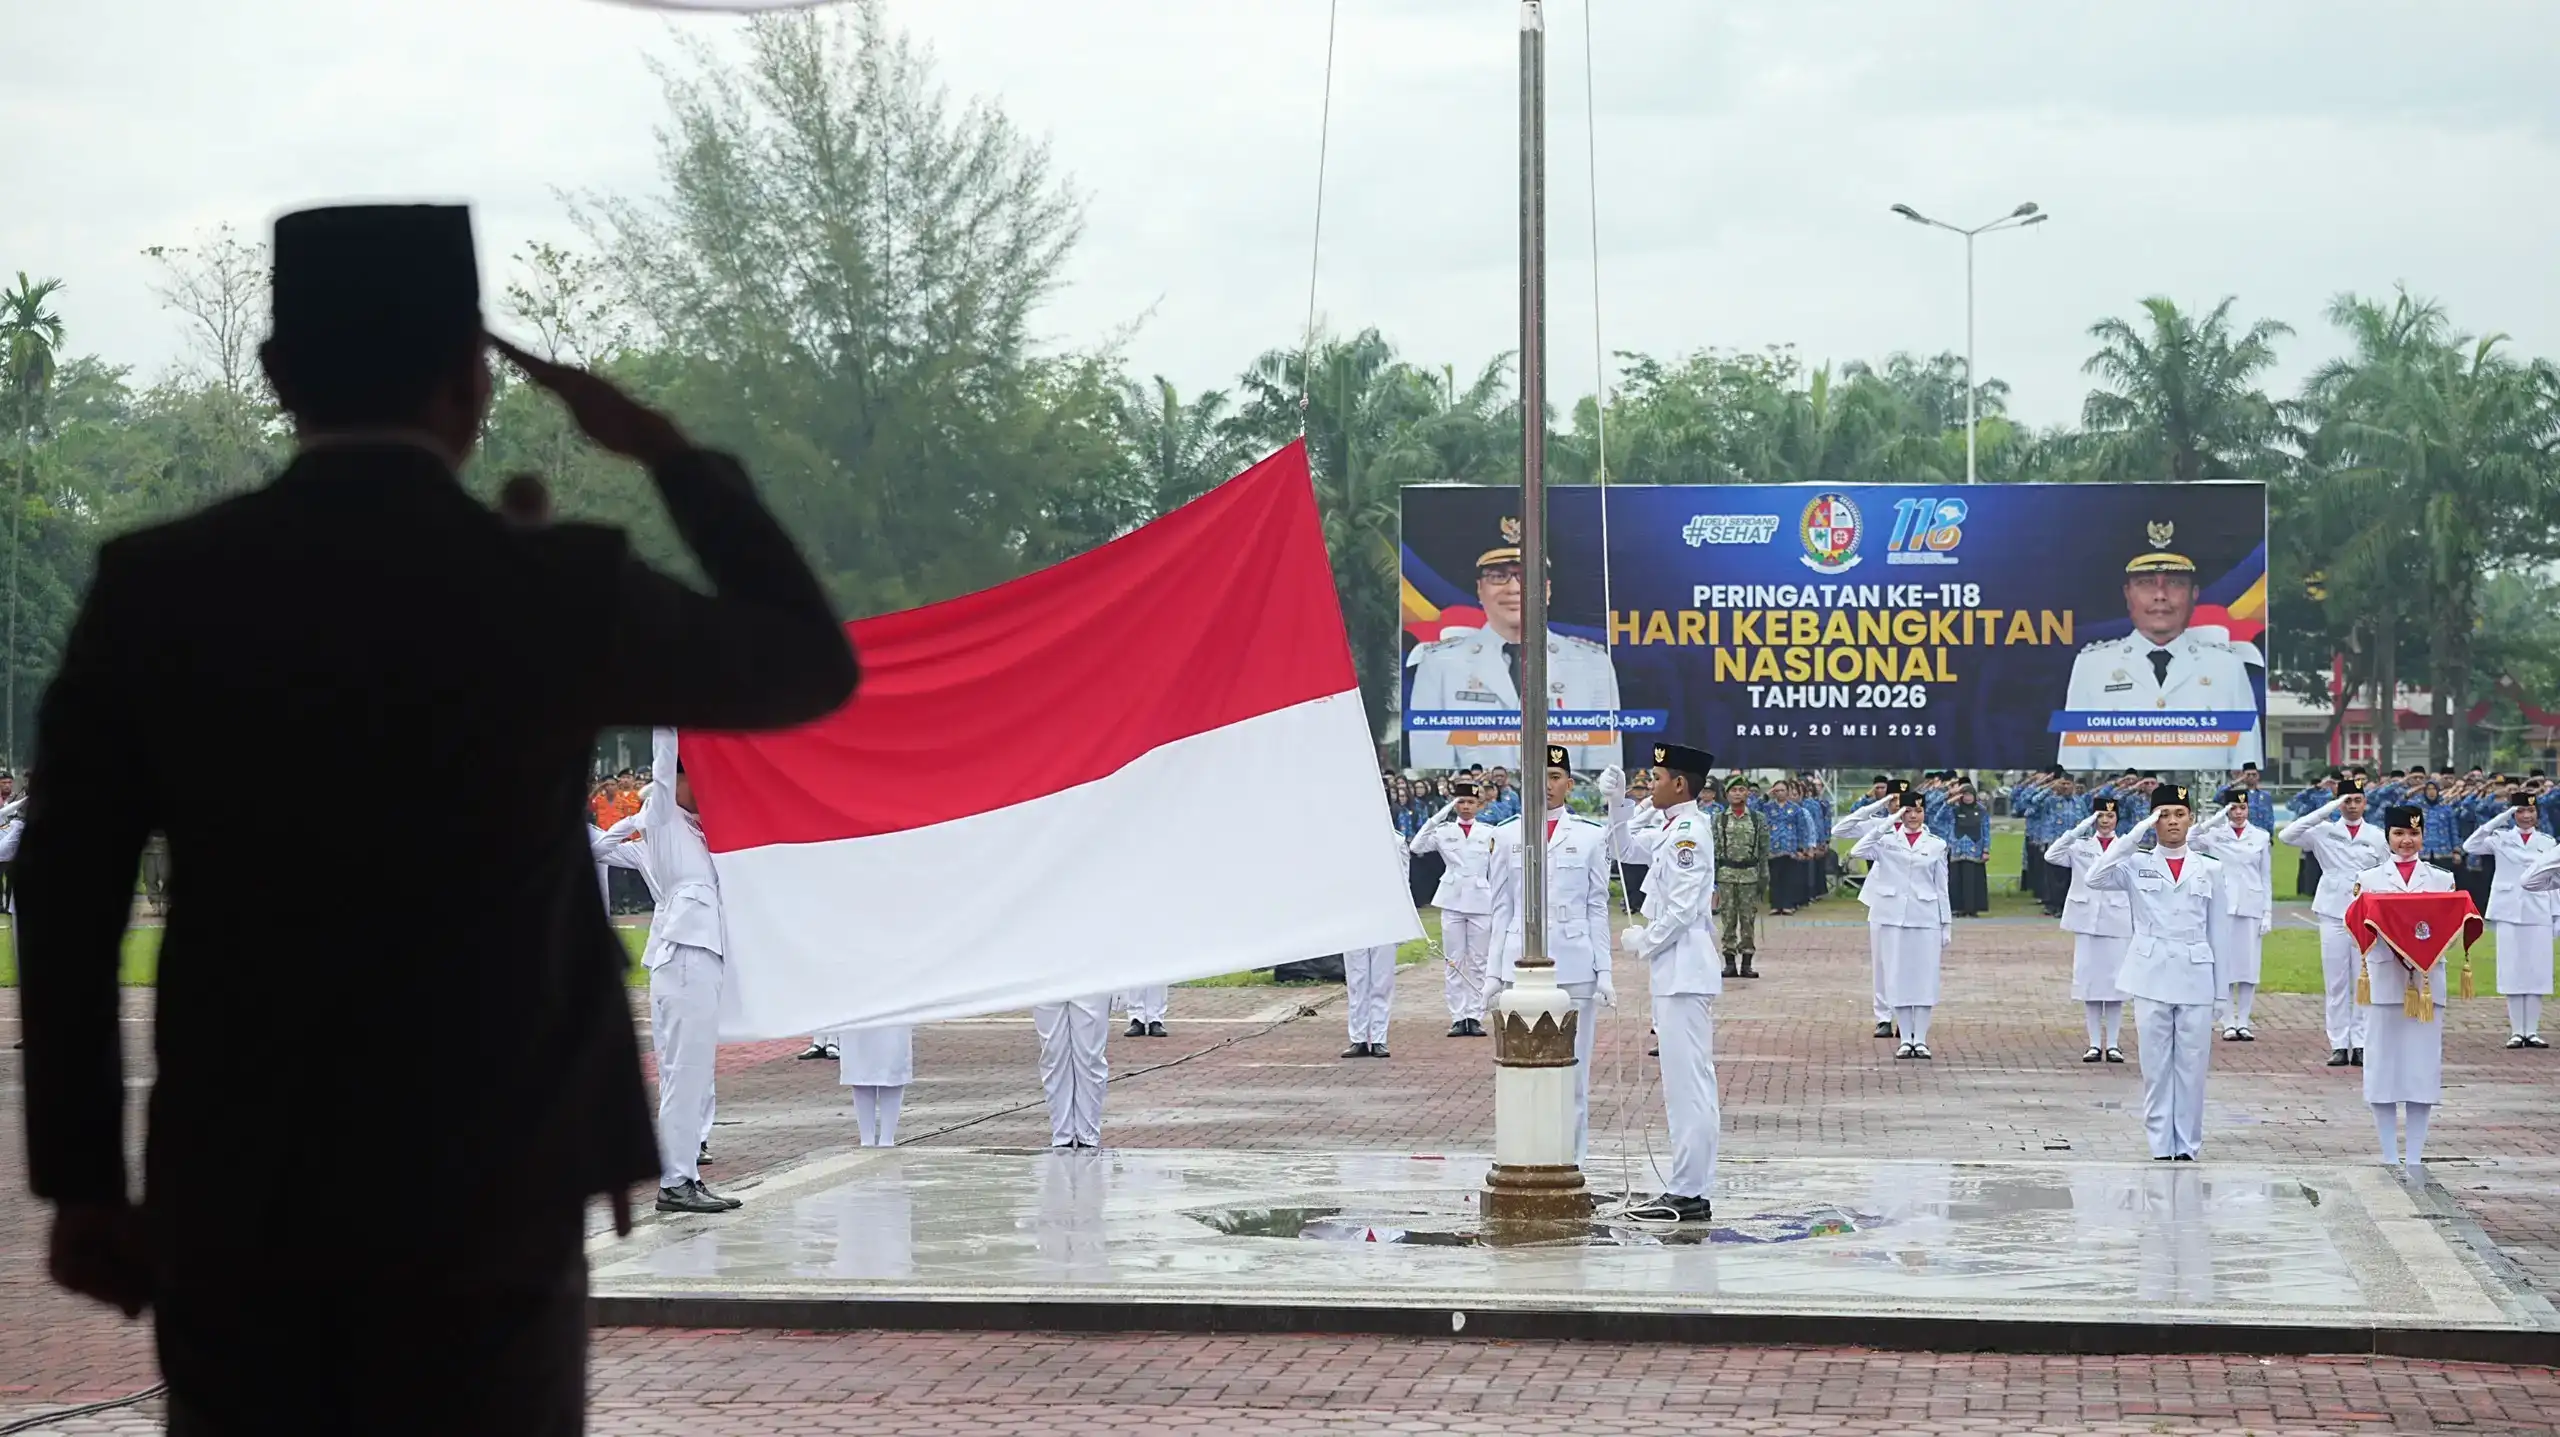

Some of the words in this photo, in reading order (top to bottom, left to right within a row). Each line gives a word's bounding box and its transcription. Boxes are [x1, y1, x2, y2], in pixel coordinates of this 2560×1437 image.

[1685, 518, 1774, 544] #SEHAT
[1704, 518, 1726, 526] DELI
[1728, 517, 1777, 526] SERDANG
[1888, 498, 1969, 551] 118
[1693, 584, 1880, 608] PERINGATAN
[1887, 583, 1981, 608] KE-118
[1609, 610, 1720, 646] HARI
[1732, 610, 2074, 646] KEBANGKITAN
[1714, 646, 1958, 682] NASIONAL
[1747, 685, 1849, 708] TAHUN
[1855, 684, 1927, 708] 2026
[1412, 716, 1428, 726] dr.
[1465, 716, 1496, 726] LUDIN
[2087, 716, 2111, 727] LOM
[2112, 716, 2136, 727] LOM
[2137, 716, 2199, 728] SUWONDO,
[2200, 716, 2218, 727] S.S
[1477, 732, 1516, 742] BUPATI
[1736, 724, 1798, 738] RABU,
[1808, 724, 1832, 736] 20
[1842, 724, 1877, 736] MEI
[1888, 724, 1937, 737] 2026
[2076, 733, 2111, 743] WAKIL
[2113, 733, 2151, 743] BUPATI
[2153, 733, 2178, 743] DELI
[2179, 733, 2229, 743] SERDANG
